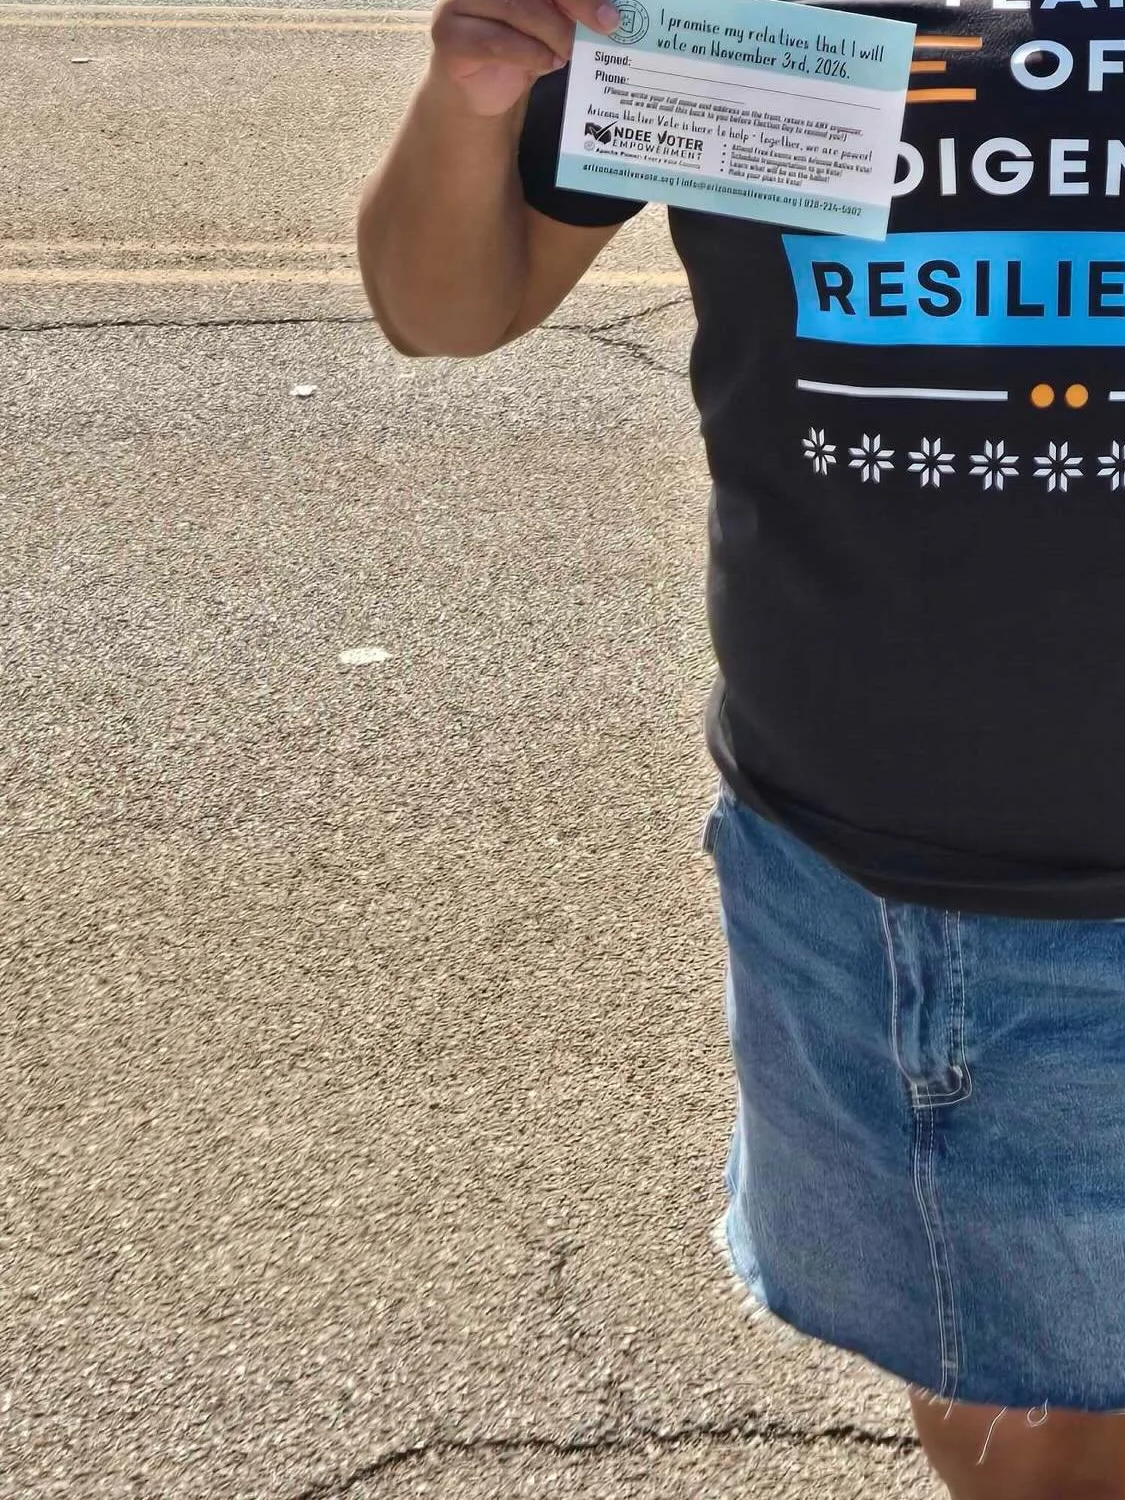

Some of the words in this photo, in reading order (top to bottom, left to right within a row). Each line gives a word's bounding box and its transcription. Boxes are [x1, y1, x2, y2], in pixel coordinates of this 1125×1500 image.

[660, 8, 665, 26] I
[667, 16, 720, 35] promise
[724, 24, 744, 43] my
[748, 26, 809, 50] relatives
[816, 34, 846, 56] that
[851, 40, 856, 58] I
[859, 45, 885, 63] will
[656, 33, 687, 52] vote
[691, 43, 706, 56] on
[710, 40, 777, 67] November
[814, 57, 850, 80] 2026.
[594, 70, 630, 85] Phone:
[612, 139, 702, 161] EMPOWERMENT
[614, 126, 652, 143] NDEE
[657, 130, 704, 152] VOTER
